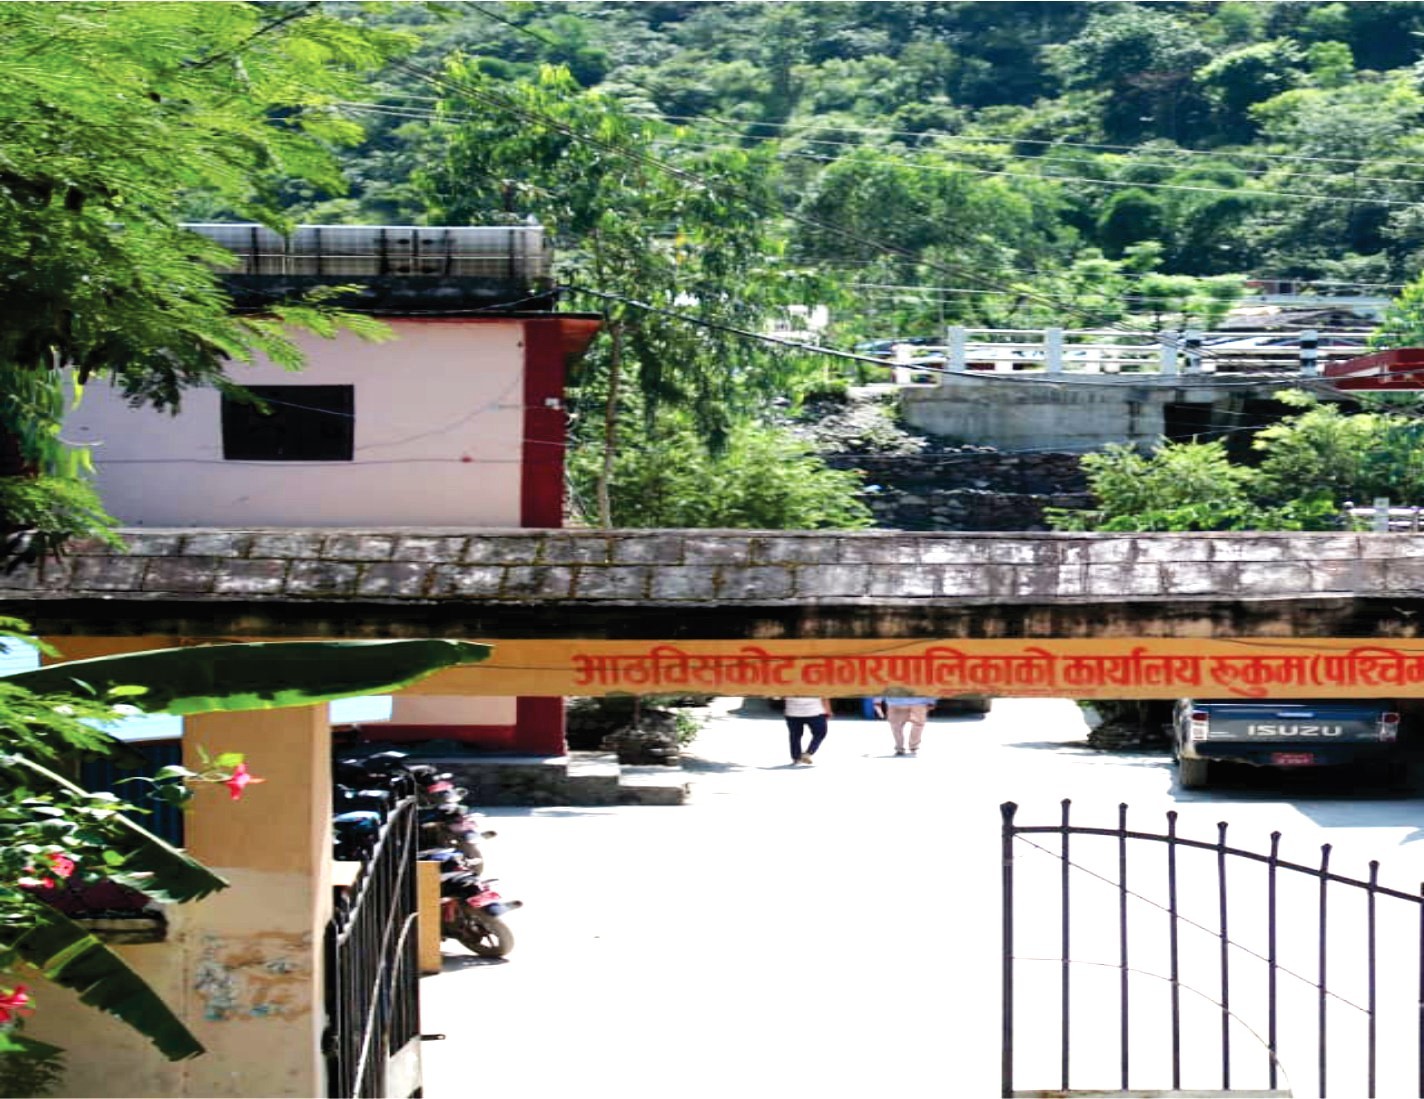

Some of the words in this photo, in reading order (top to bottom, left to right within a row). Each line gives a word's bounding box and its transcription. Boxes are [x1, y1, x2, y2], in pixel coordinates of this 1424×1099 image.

[571, 645, 797, 685] आठविसकोट
[800, 646, 1056, 686] नगरपालिकाको
[1062, 646, 1203, 686] कार्यालय
[1248, 725, 1342, 737] ISUZU
